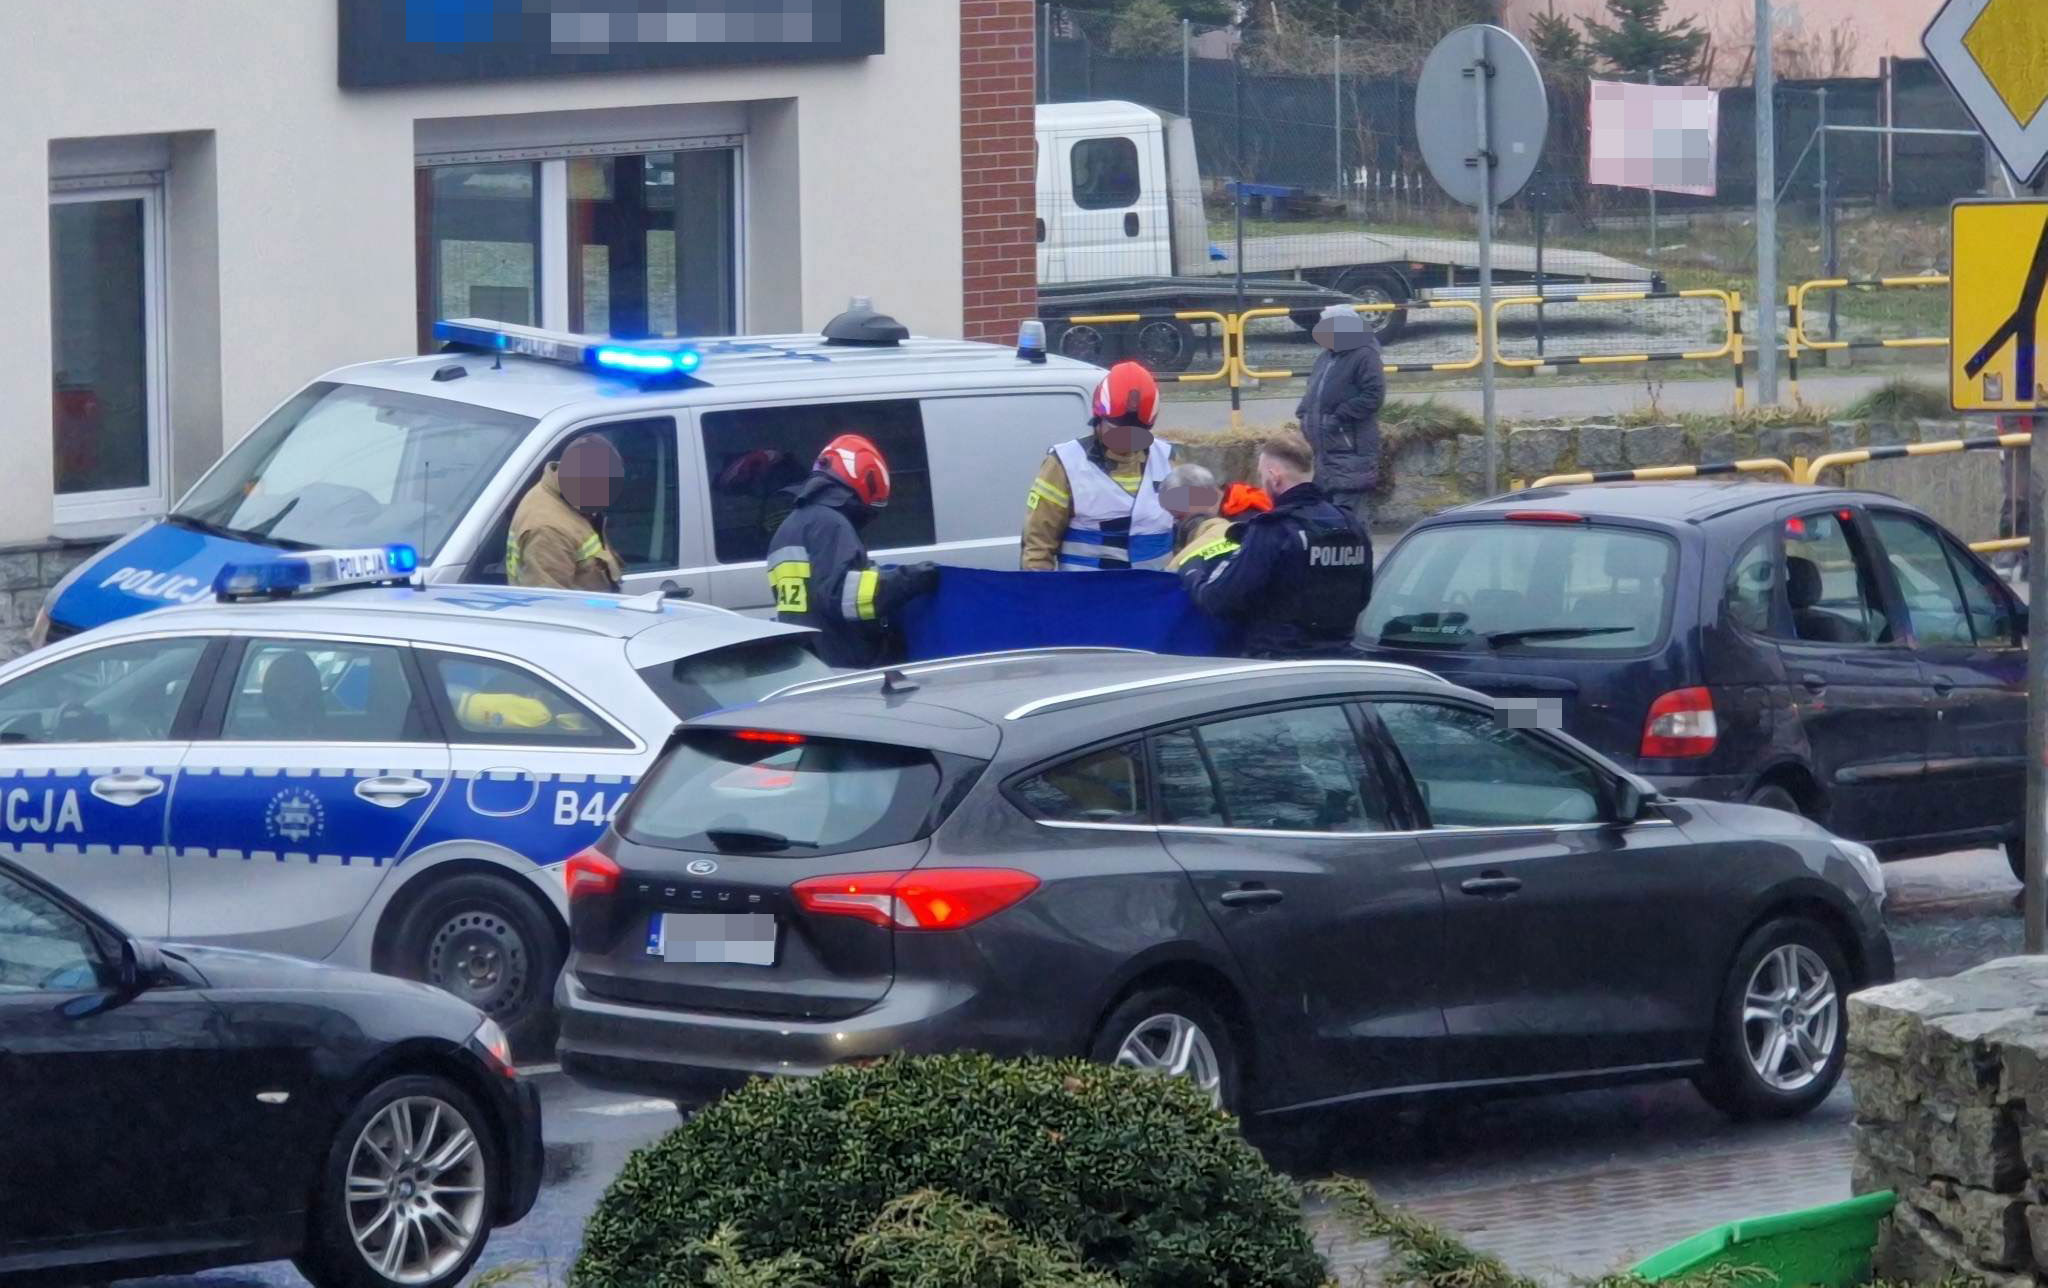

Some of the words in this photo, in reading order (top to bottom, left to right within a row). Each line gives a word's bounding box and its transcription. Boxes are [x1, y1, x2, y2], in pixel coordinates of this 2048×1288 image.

[338, 554, 384, 578] POLICJA
[99, 567, 212, 602] POLICJ
[0, 787, 84, 833] CJA
